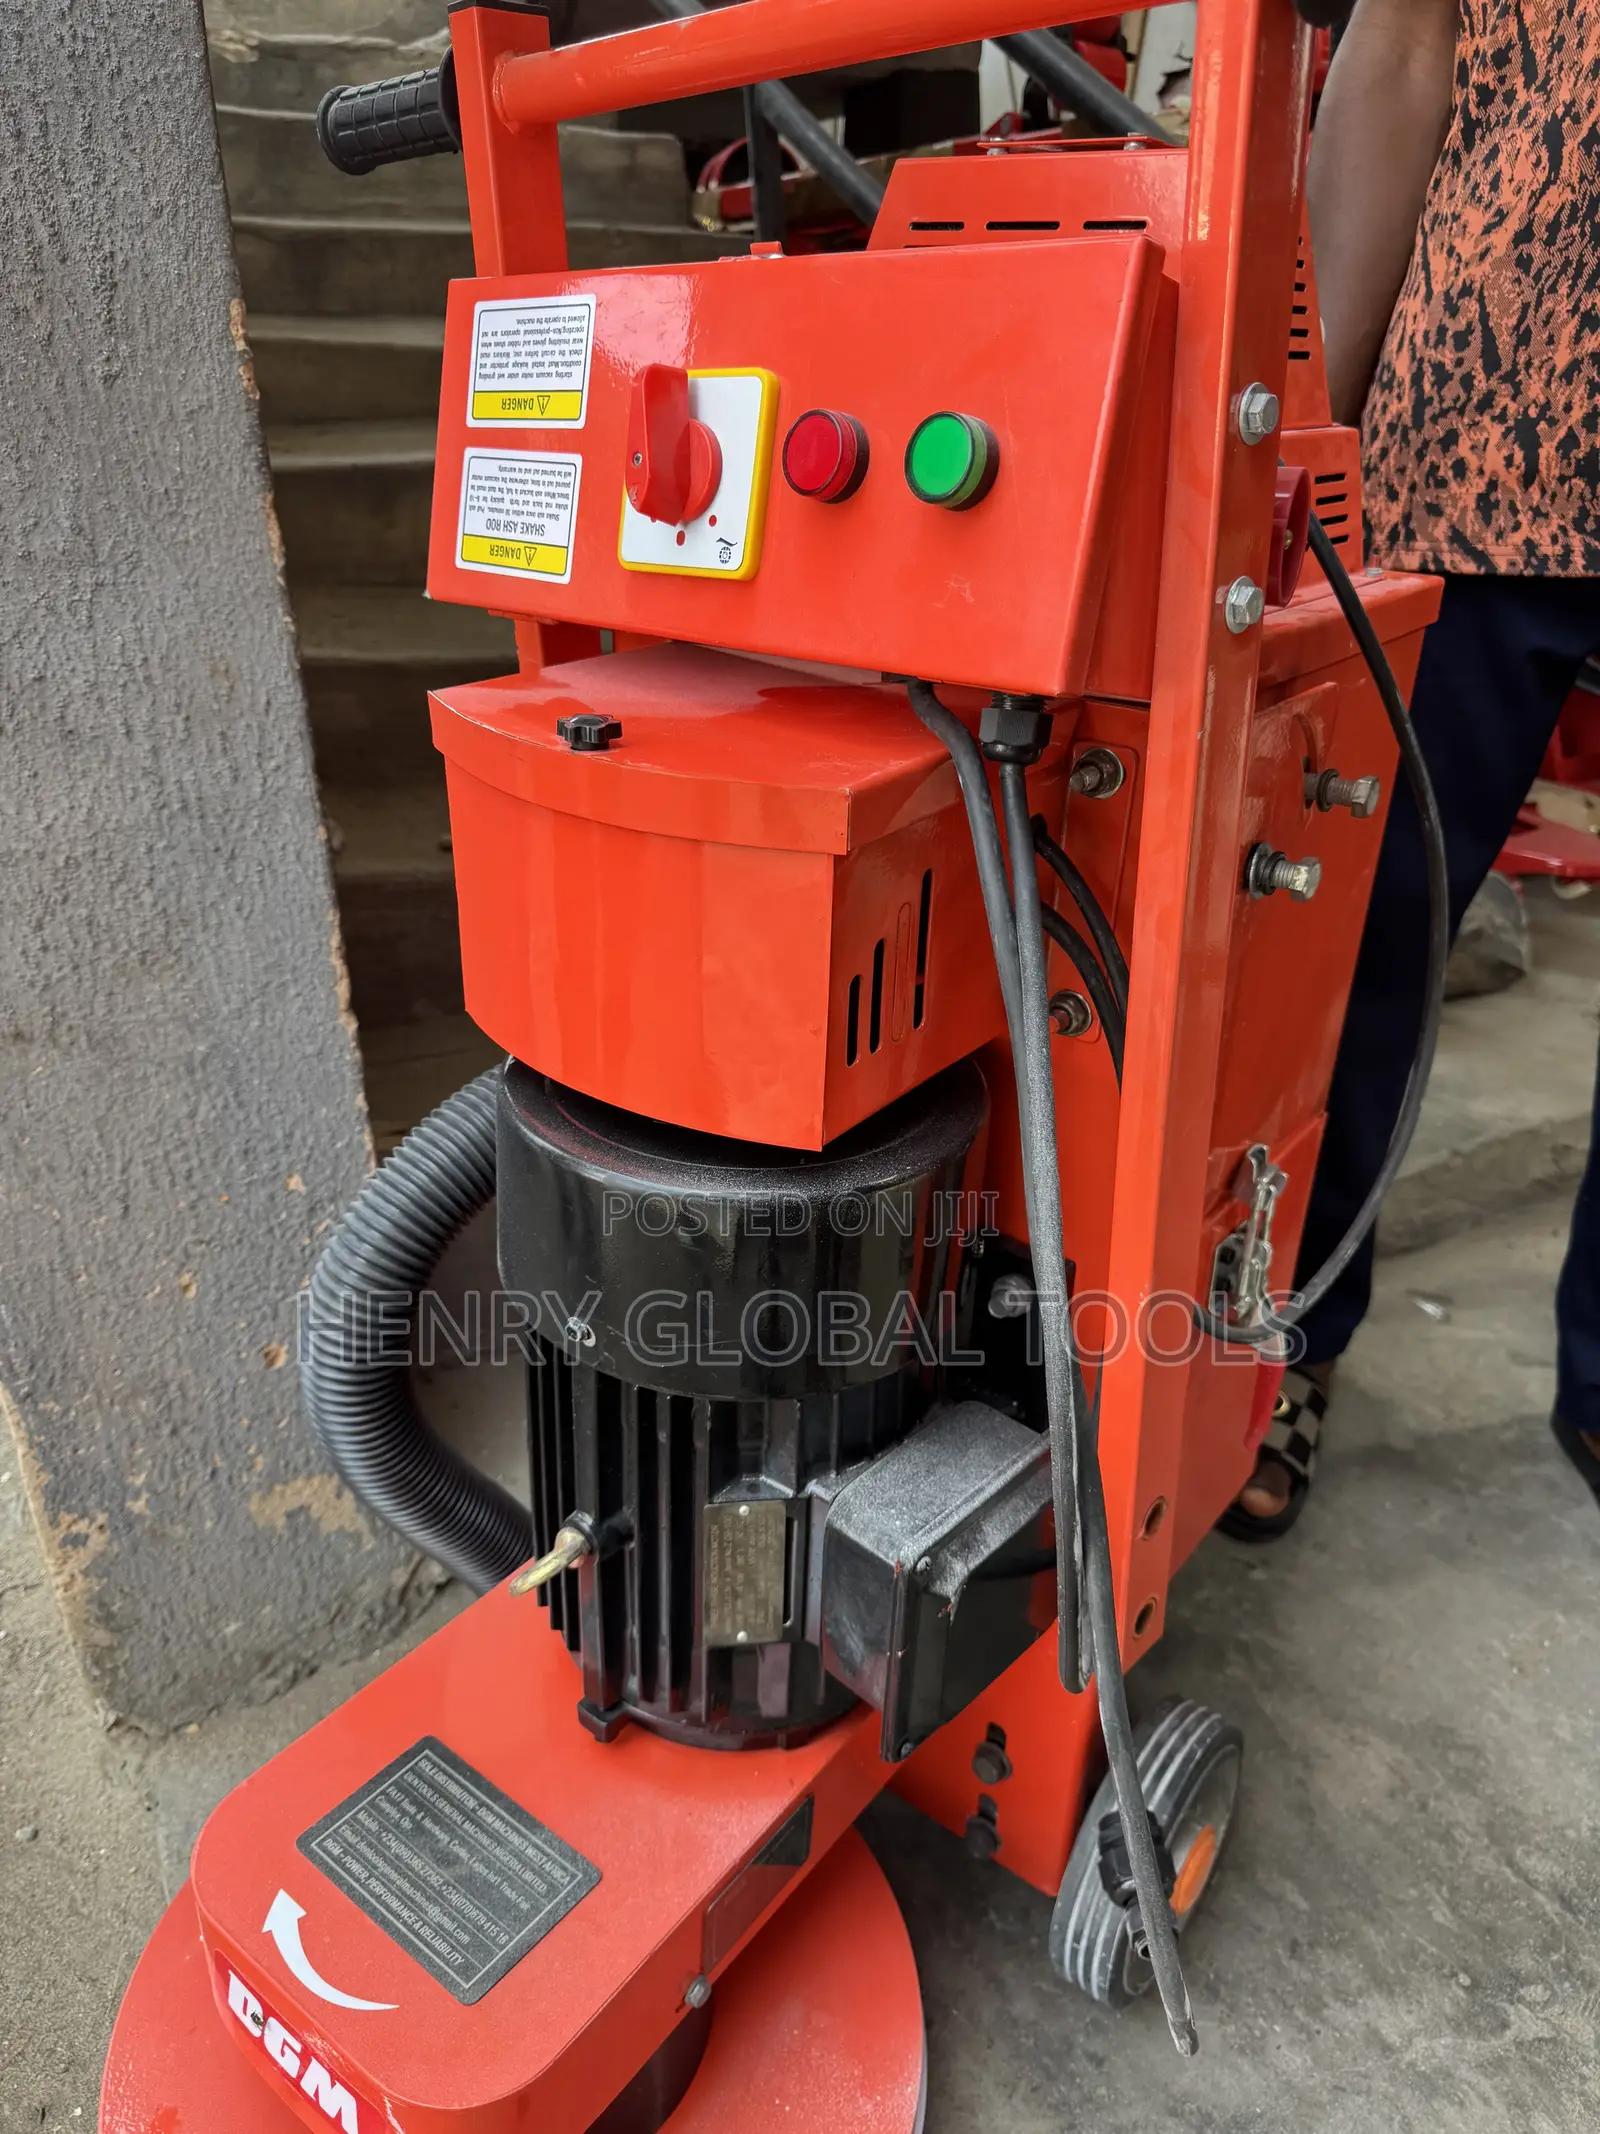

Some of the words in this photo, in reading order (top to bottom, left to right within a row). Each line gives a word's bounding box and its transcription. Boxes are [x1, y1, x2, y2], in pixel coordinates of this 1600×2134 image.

[544, 316, 561, 324] operate
[568, 315, 585, 323] allowed
[533, 338, 547, 347] gloves
[549, 338, 570, 346] insulating
[569, 349, 582, 357] check
[490, 361, 509, 369] protector
[512, 361, 528, 370] leakage
[479, 372, 495, 382] grinding
[555, 371, 572, 379] starting
[501, 398, 534, 410] DANGER
[555, 503, 568, 511] shake
[546, 513, 560, 521] Shake
[486, 518, 501, 531] ROD
[503, 520, 518, 534] ASH
[520, 522, 545, 536] SHAKE
[489, 545, 521, 559] DANGER
[416, 1757, 439, 1776] SOLE
[490, 1817, 530, 1851] MACHINES
[522, 1843, 548, 1866] WEST
[322, 1836, 343, 1856] DGM
[340, 1853, 371, 1882] POWER,
[364, 1875, 419, 1926] PERFORMANCE
[417, 1923, 465, 1968] RELIABILITY
[228, 1969, 358, 2134] DGM
